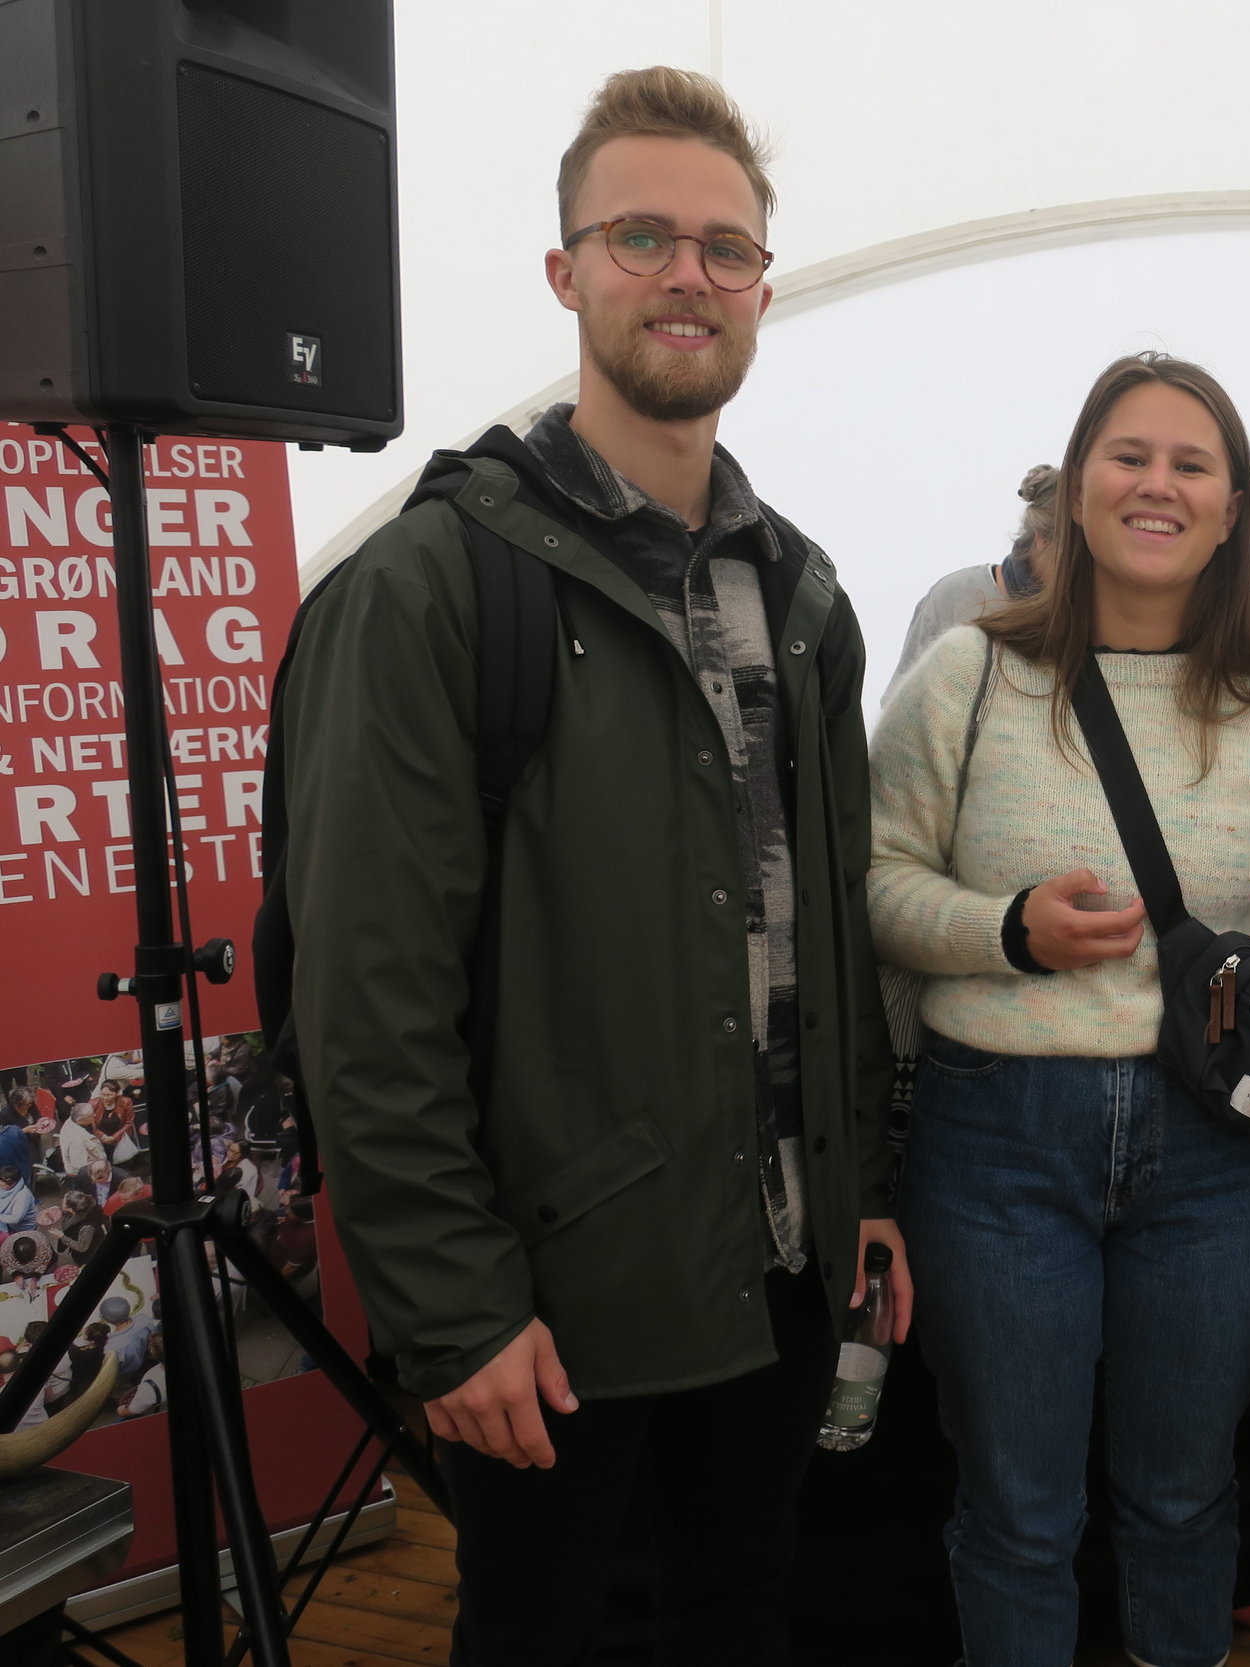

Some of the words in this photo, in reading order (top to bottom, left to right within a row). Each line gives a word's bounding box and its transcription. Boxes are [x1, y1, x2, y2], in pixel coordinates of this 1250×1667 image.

[0, 438, 245, 479] OPLELSER
[0, 555, 256, 600] GRØNAND
[31, 725, 269, 773] NETÆRK
